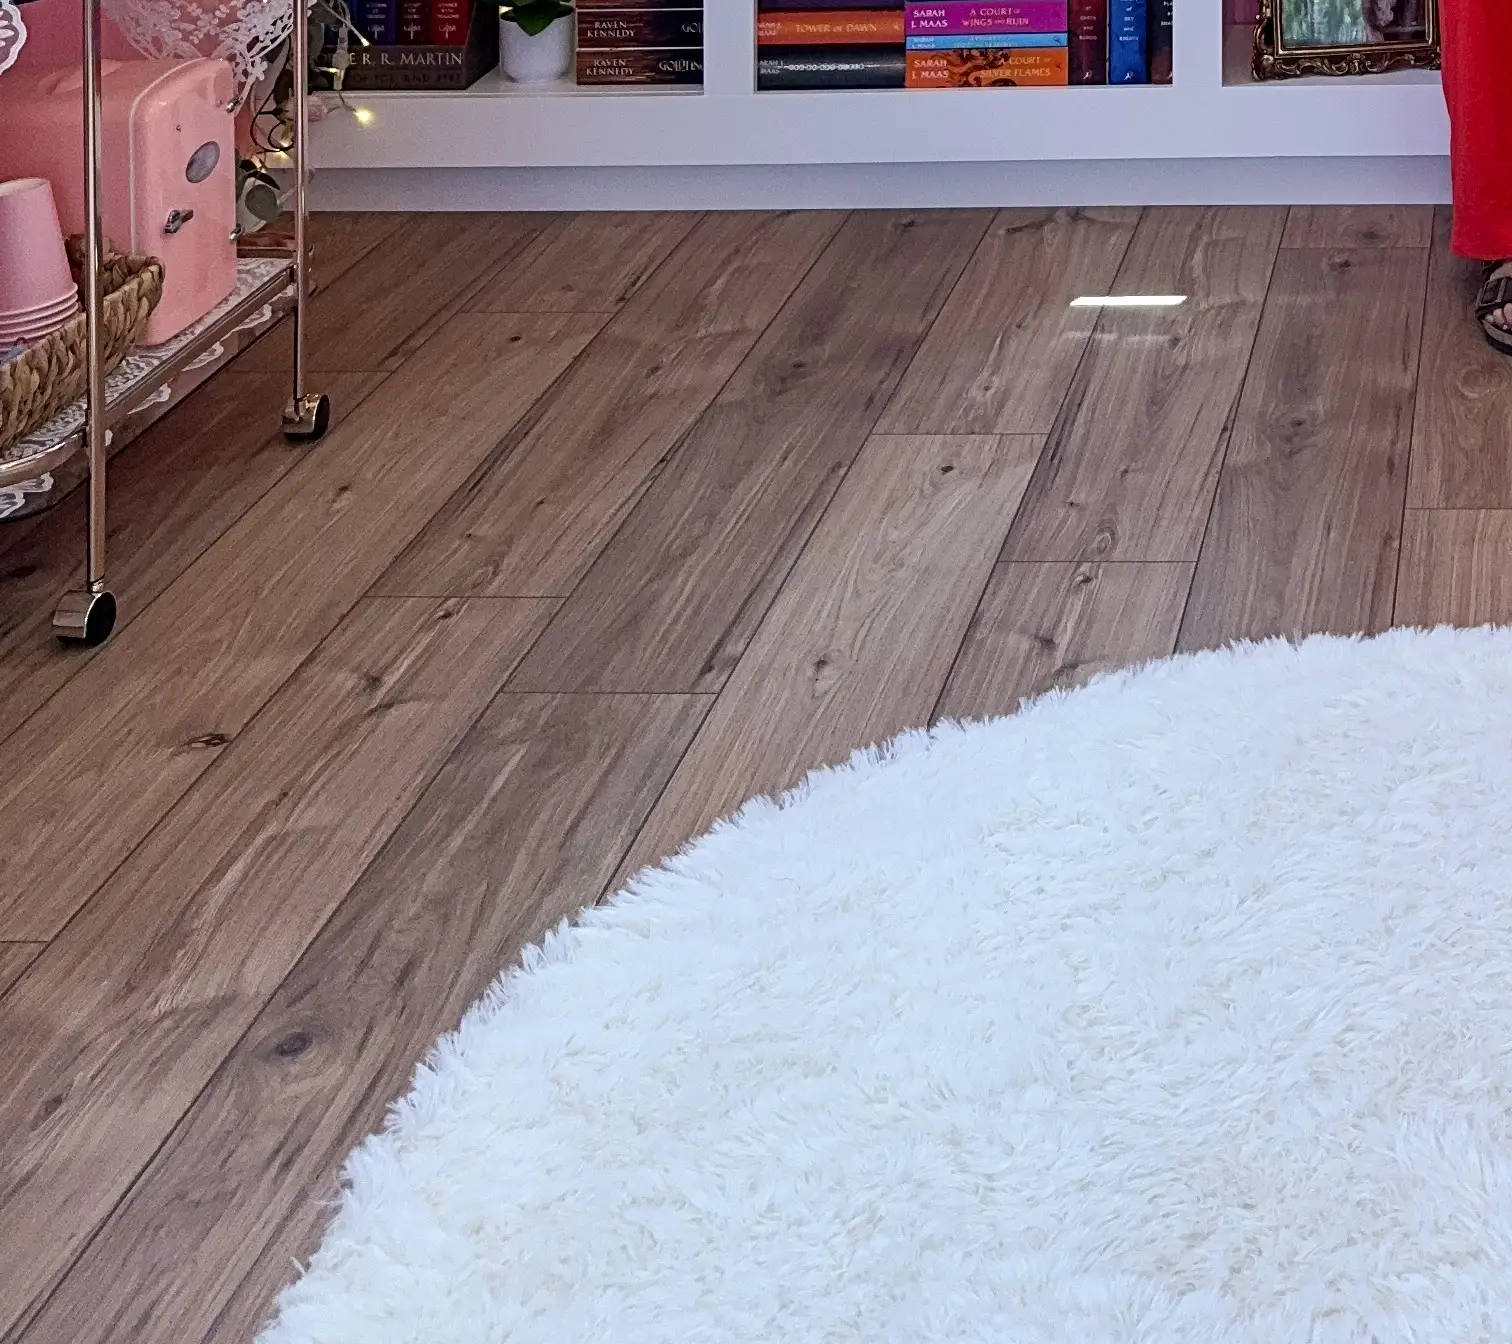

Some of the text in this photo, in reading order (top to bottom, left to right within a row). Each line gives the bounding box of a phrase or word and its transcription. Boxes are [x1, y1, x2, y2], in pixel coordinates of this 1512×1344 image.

[913, 9, 947, 17] SARAH
[919, 19, 949, 28] MAAS
[1005, 17, 1029, 25] RUIN
[796, 23, 877, 32] TOWER DAWN
[400, 51, 463, 66] MARTIN
[913, 58, 947, 68] SARAH
[1008, 56, 1041, 64] COURT
[919, 70, 949, 79] MAAS
